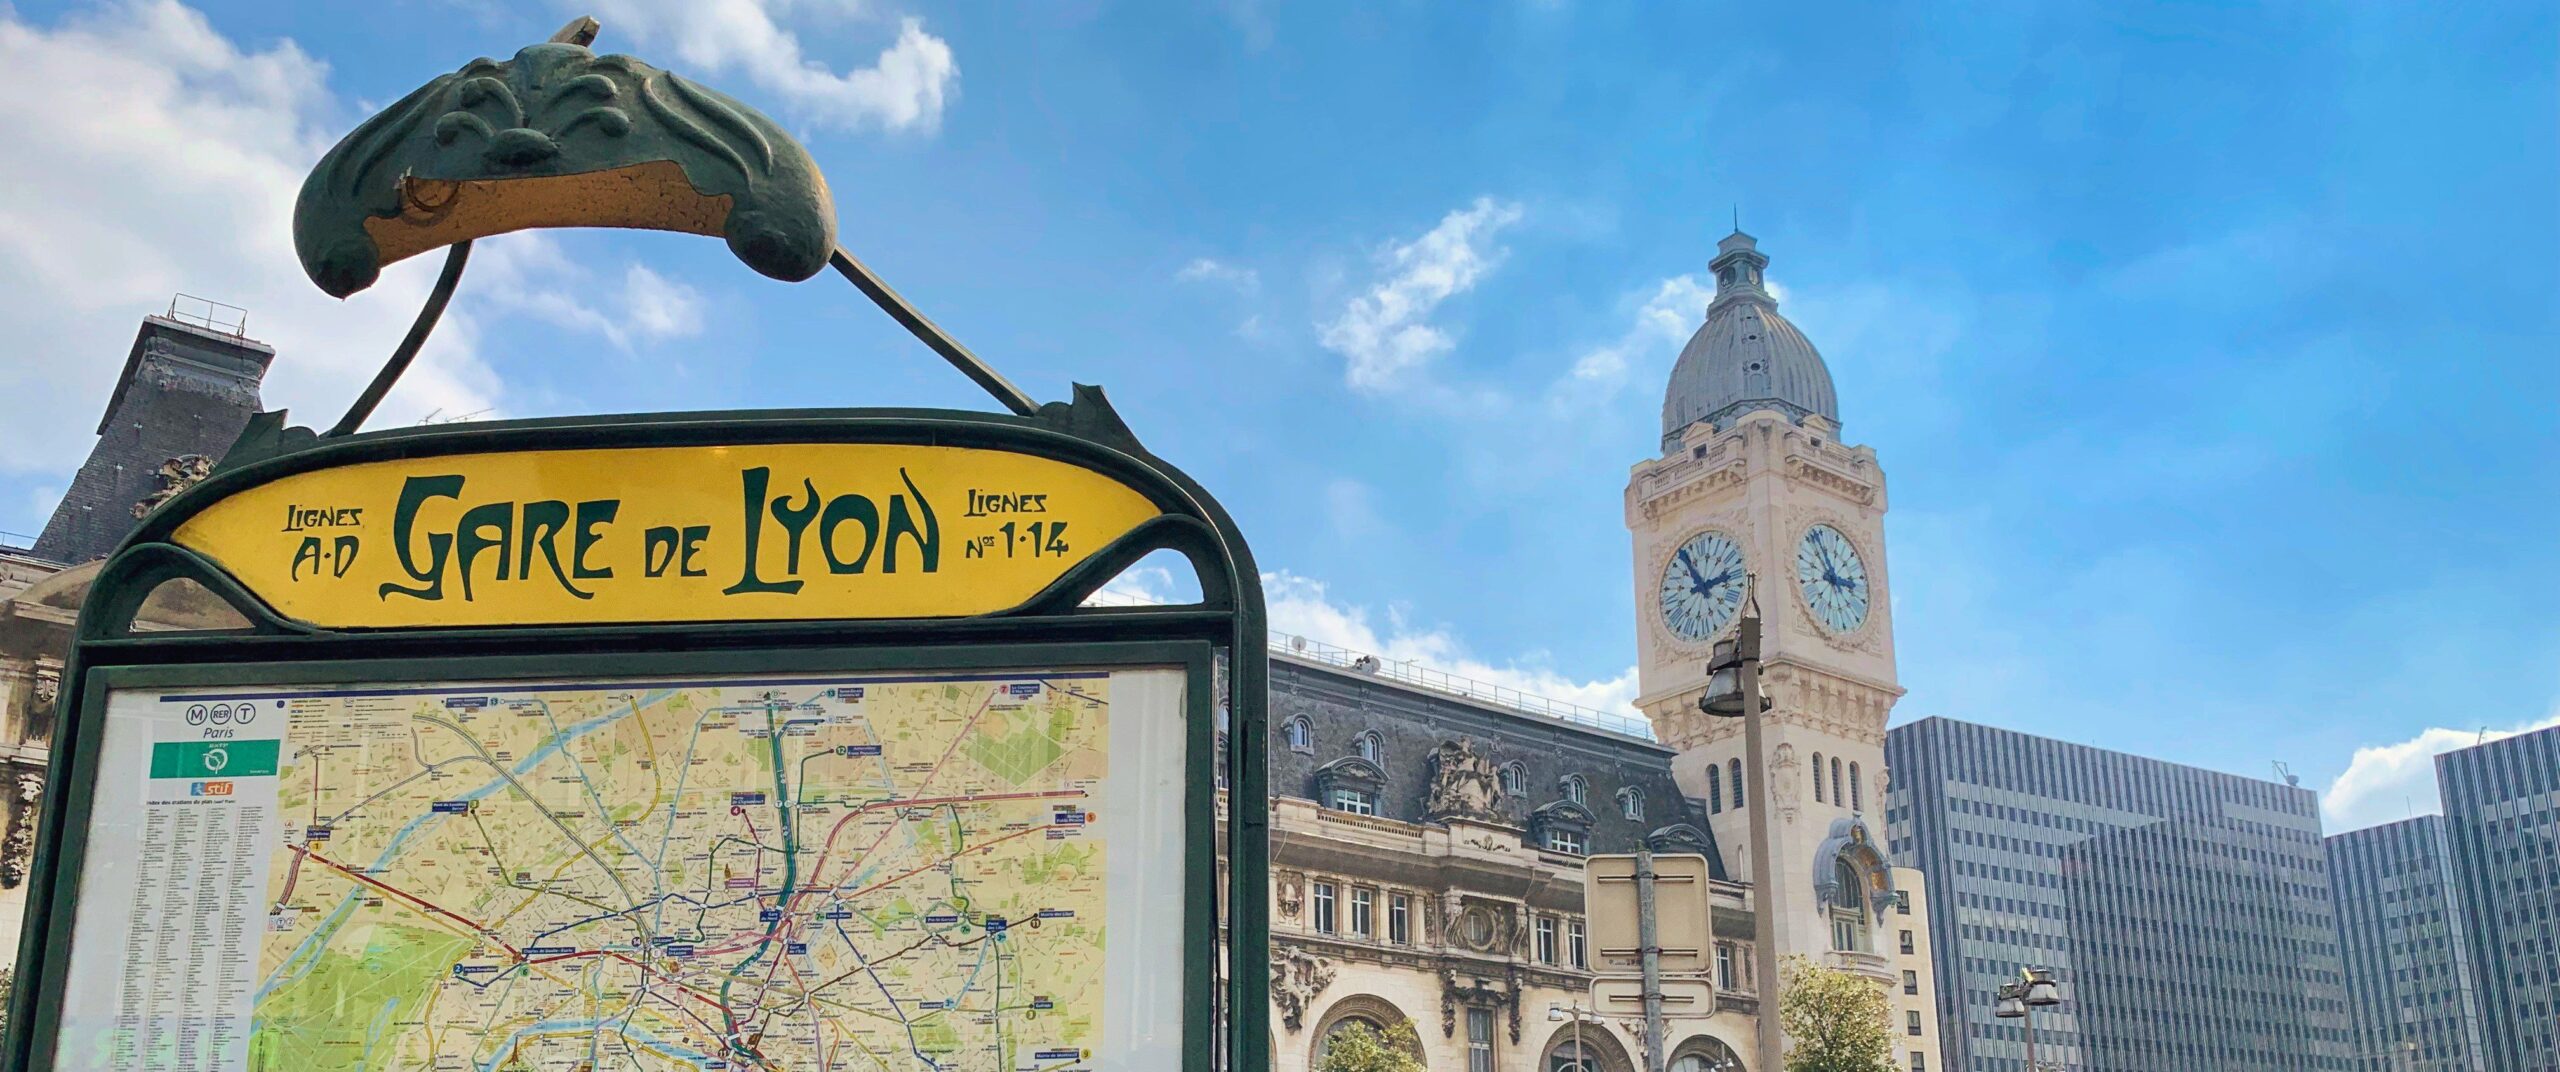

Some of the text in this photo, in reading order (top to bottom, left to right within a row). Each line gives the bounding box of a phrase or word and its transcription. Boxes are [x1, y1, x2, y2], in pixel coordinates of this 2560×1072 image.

[379, 467, 939, 601] GARE DE LYON
[190, 708, 250, 721] M RER T
[203, 727, 234, 738] Paris
[207, 783, 229, 794] stif
